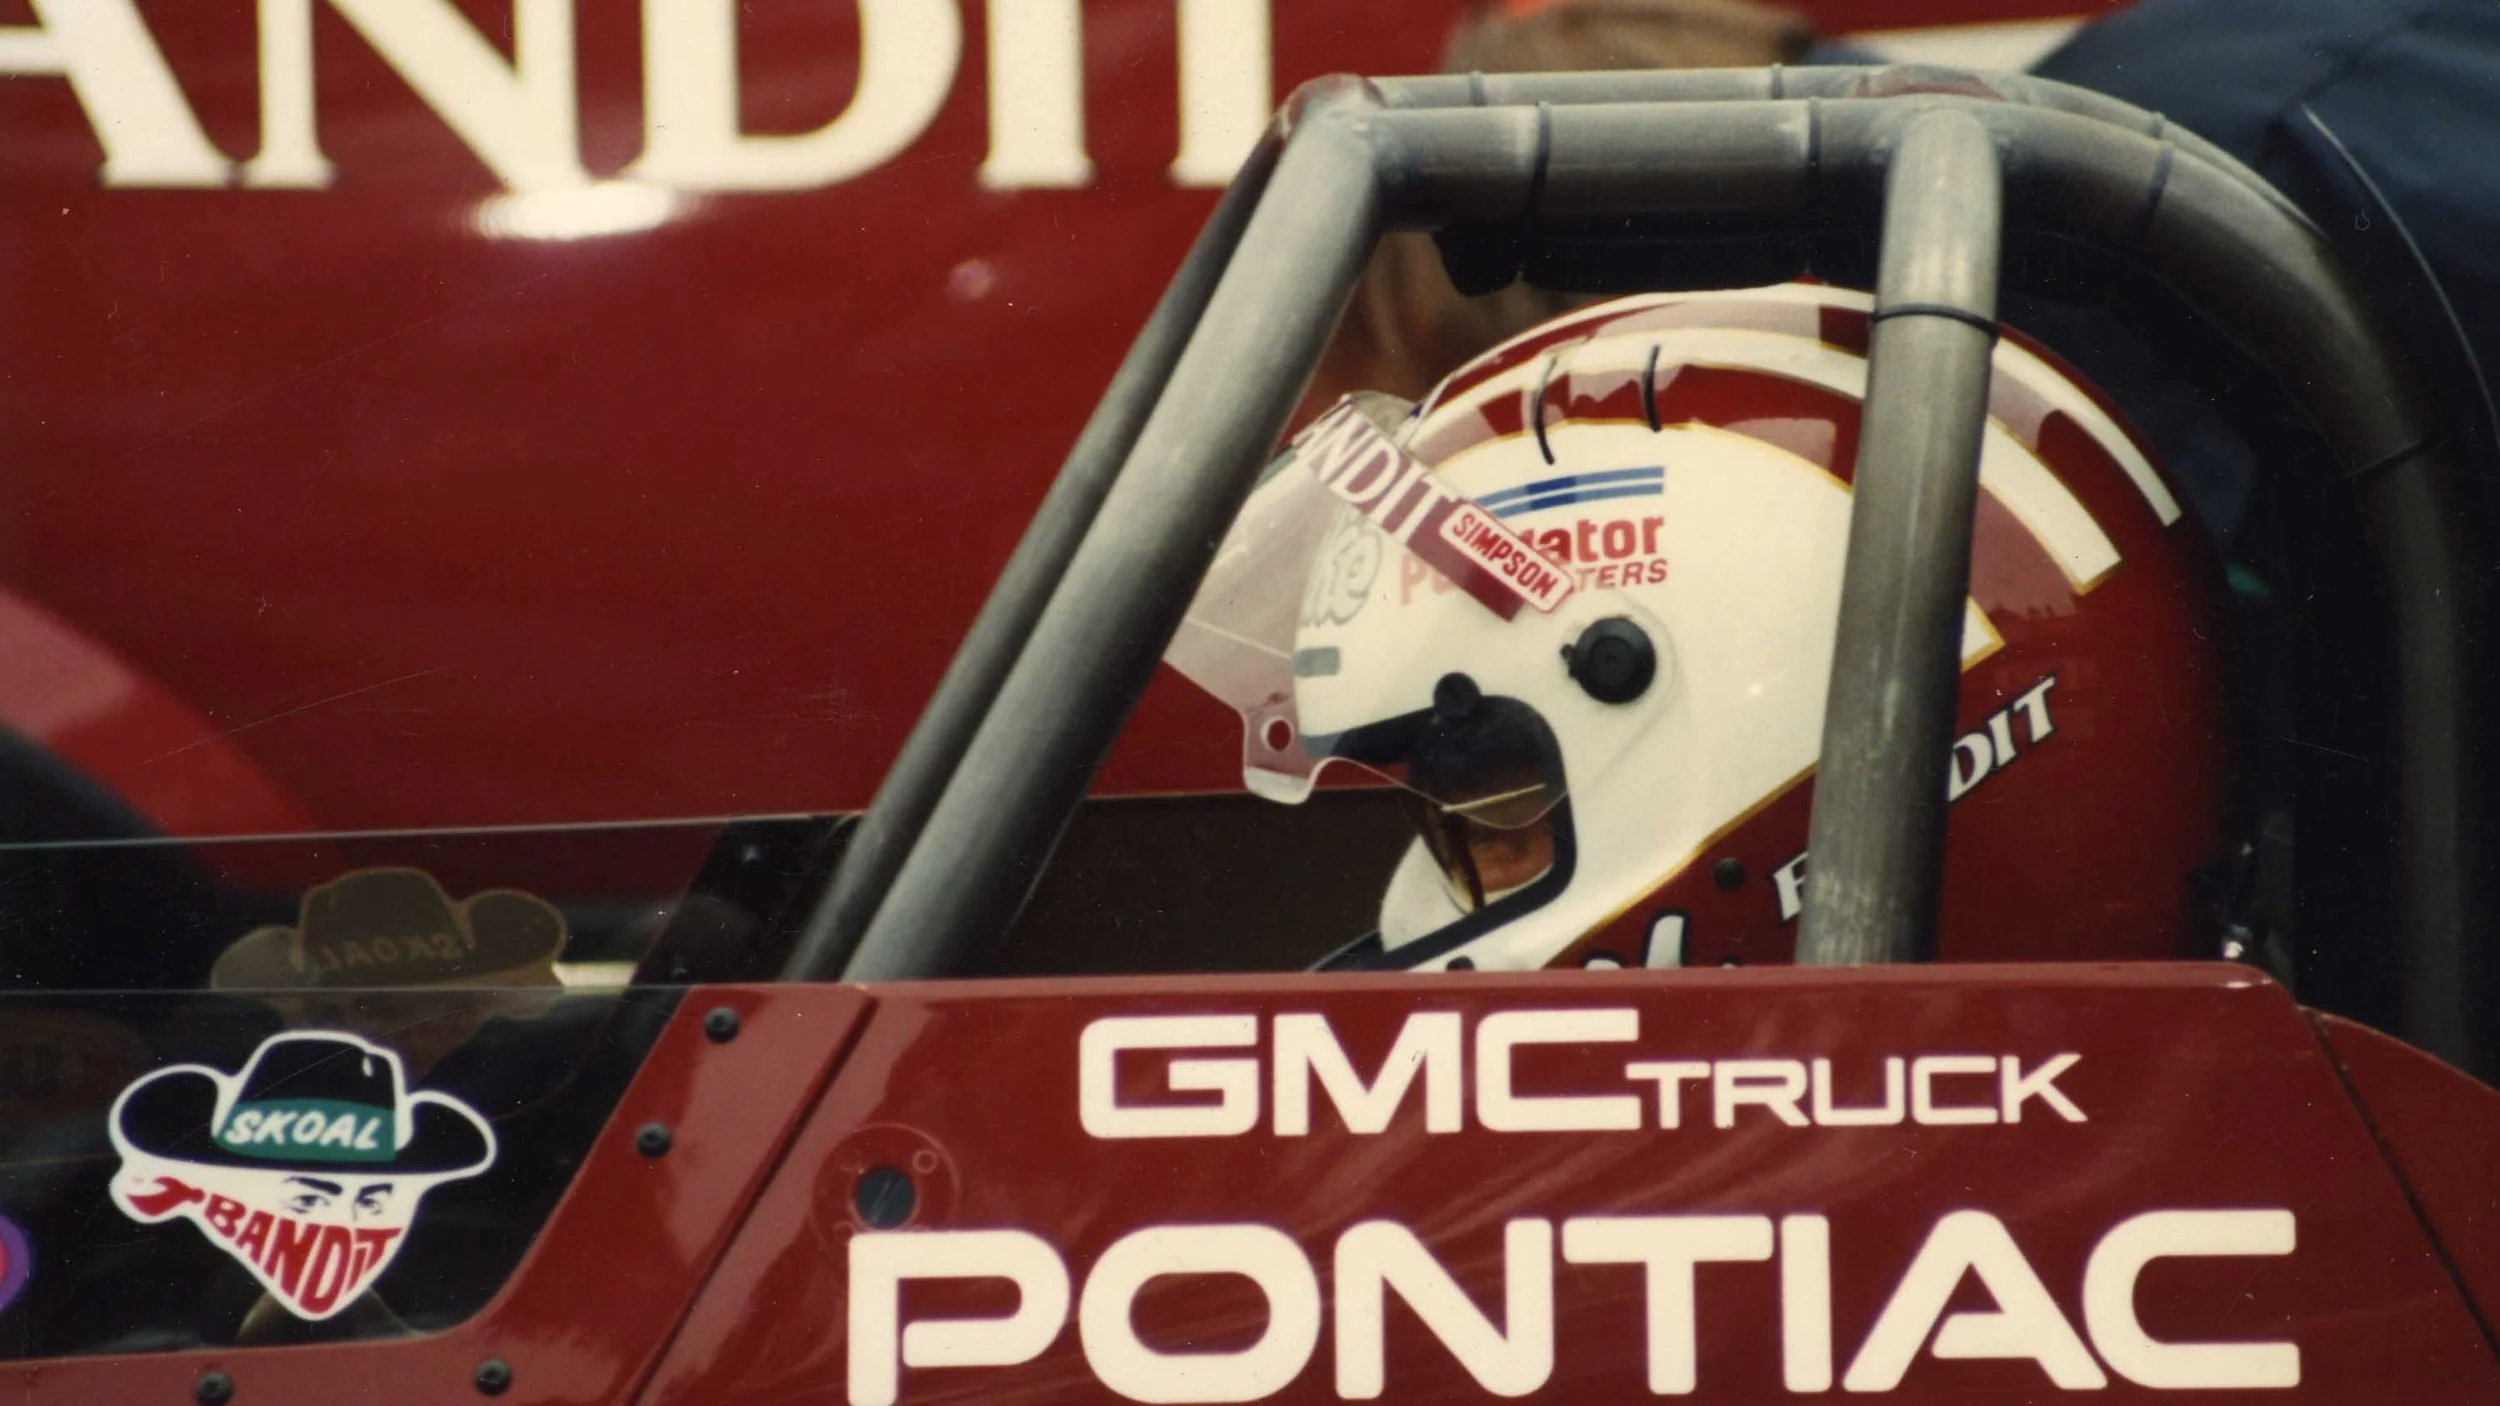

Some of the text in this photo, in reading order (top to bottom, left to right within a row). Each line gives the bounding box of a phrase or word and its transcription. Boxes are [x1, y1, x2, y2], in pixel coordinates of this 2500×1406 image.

[1452, 512, 1558, 599] SIMPSON
[223, 1109, 382, 1151] SKOAL
[1078, 1008, 2088, 1139] GMC TRUCK
[203, 1193, 403, 1315] BANDIT
[847, 1209, 2301, 1406] PONTIAC
